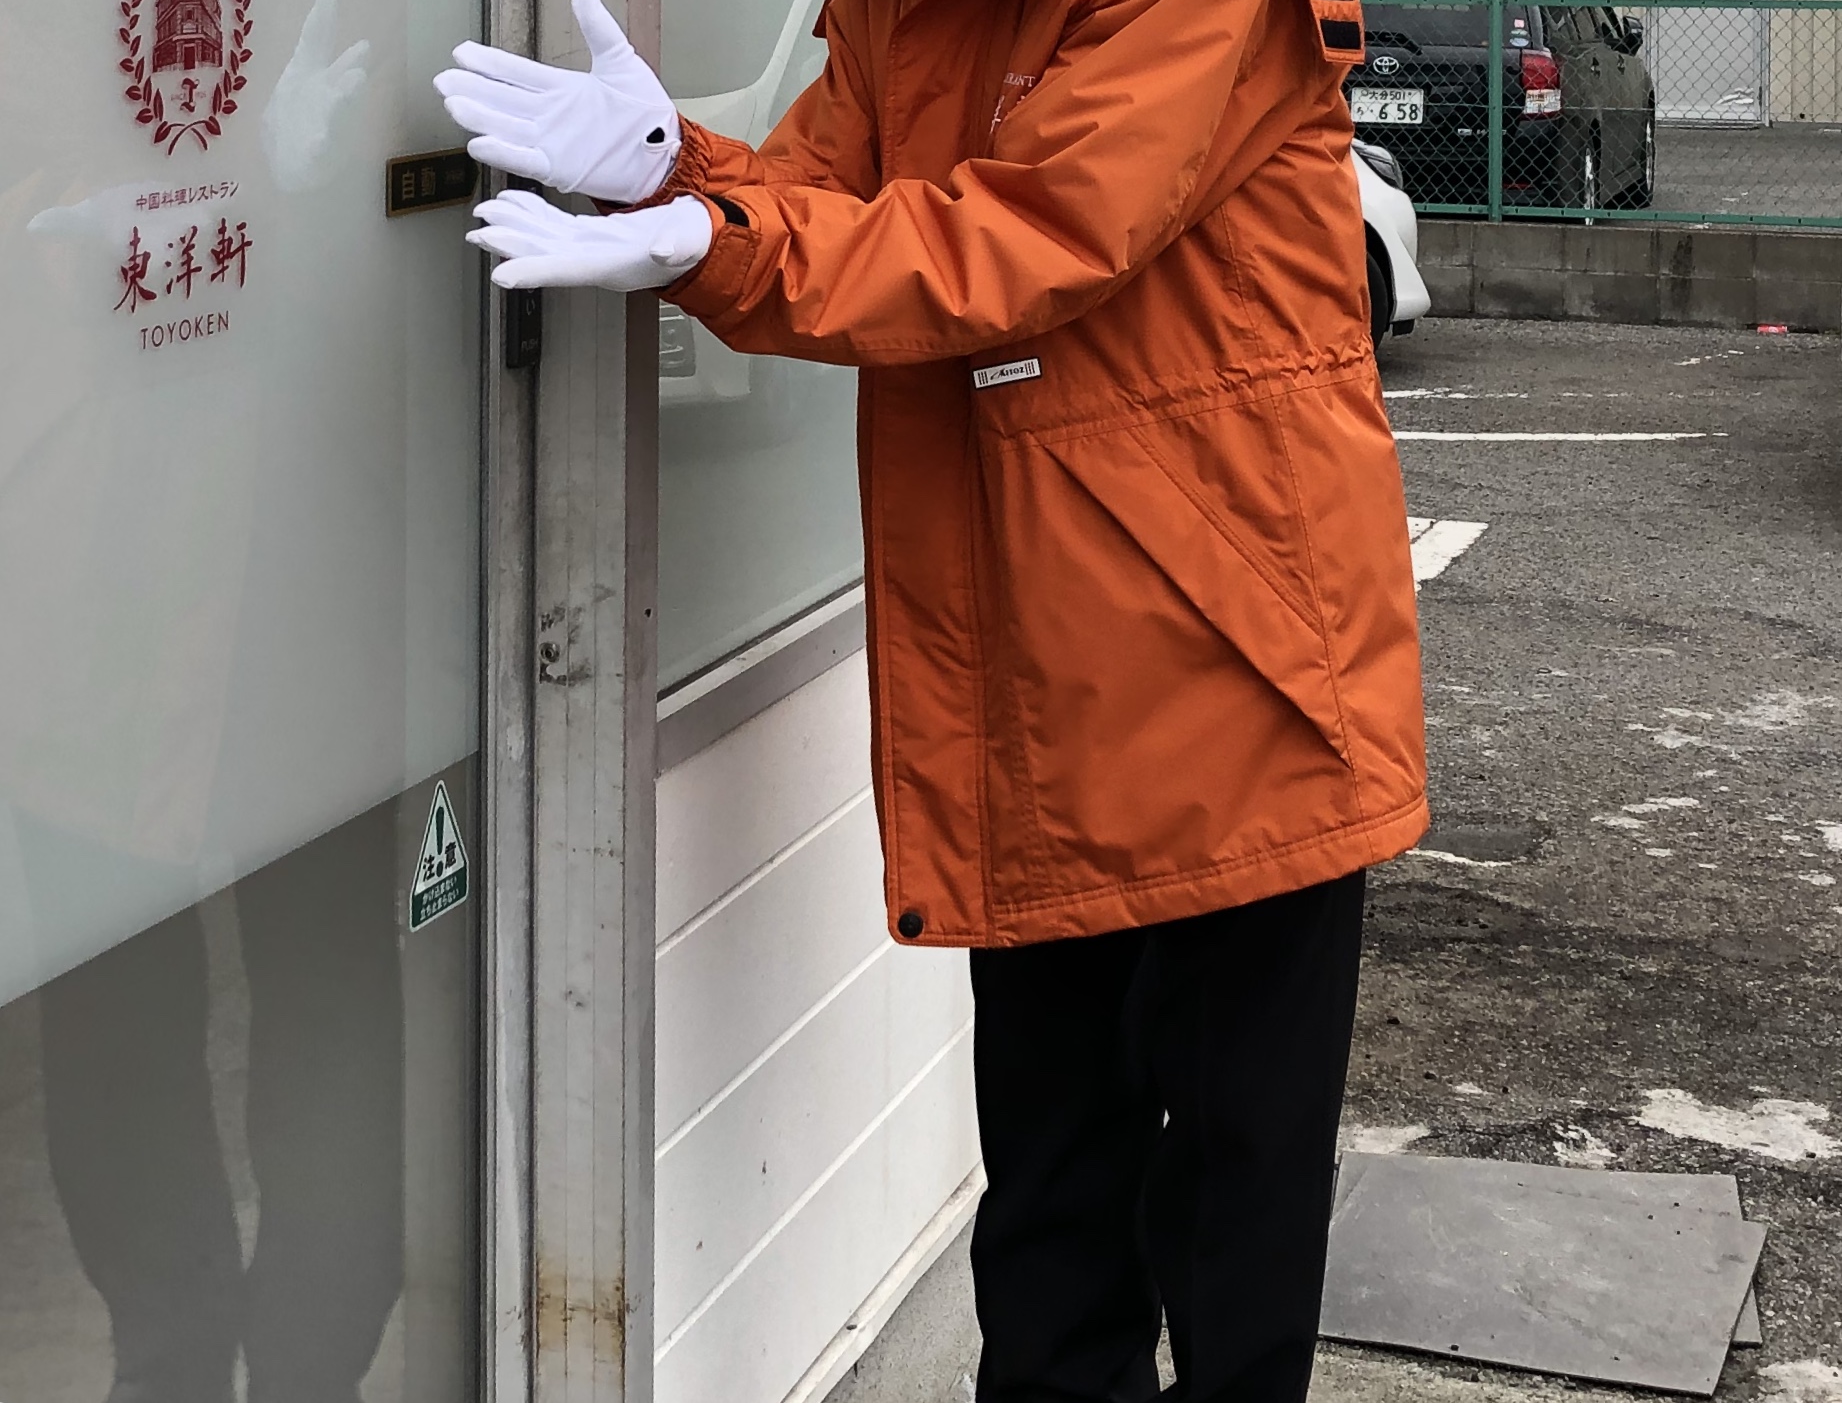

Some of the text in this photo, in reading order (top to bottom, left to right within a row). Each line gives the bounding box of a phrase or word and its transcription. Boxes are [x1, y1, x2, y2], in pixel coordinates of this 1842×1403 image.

[136, 182, 240, 211] 中国料理レストラン
[113, 217, 253, 313] 東洋軒
[141, 310, 229, 349] TOYOKEN
[423, 841, 457, 882] 注意
